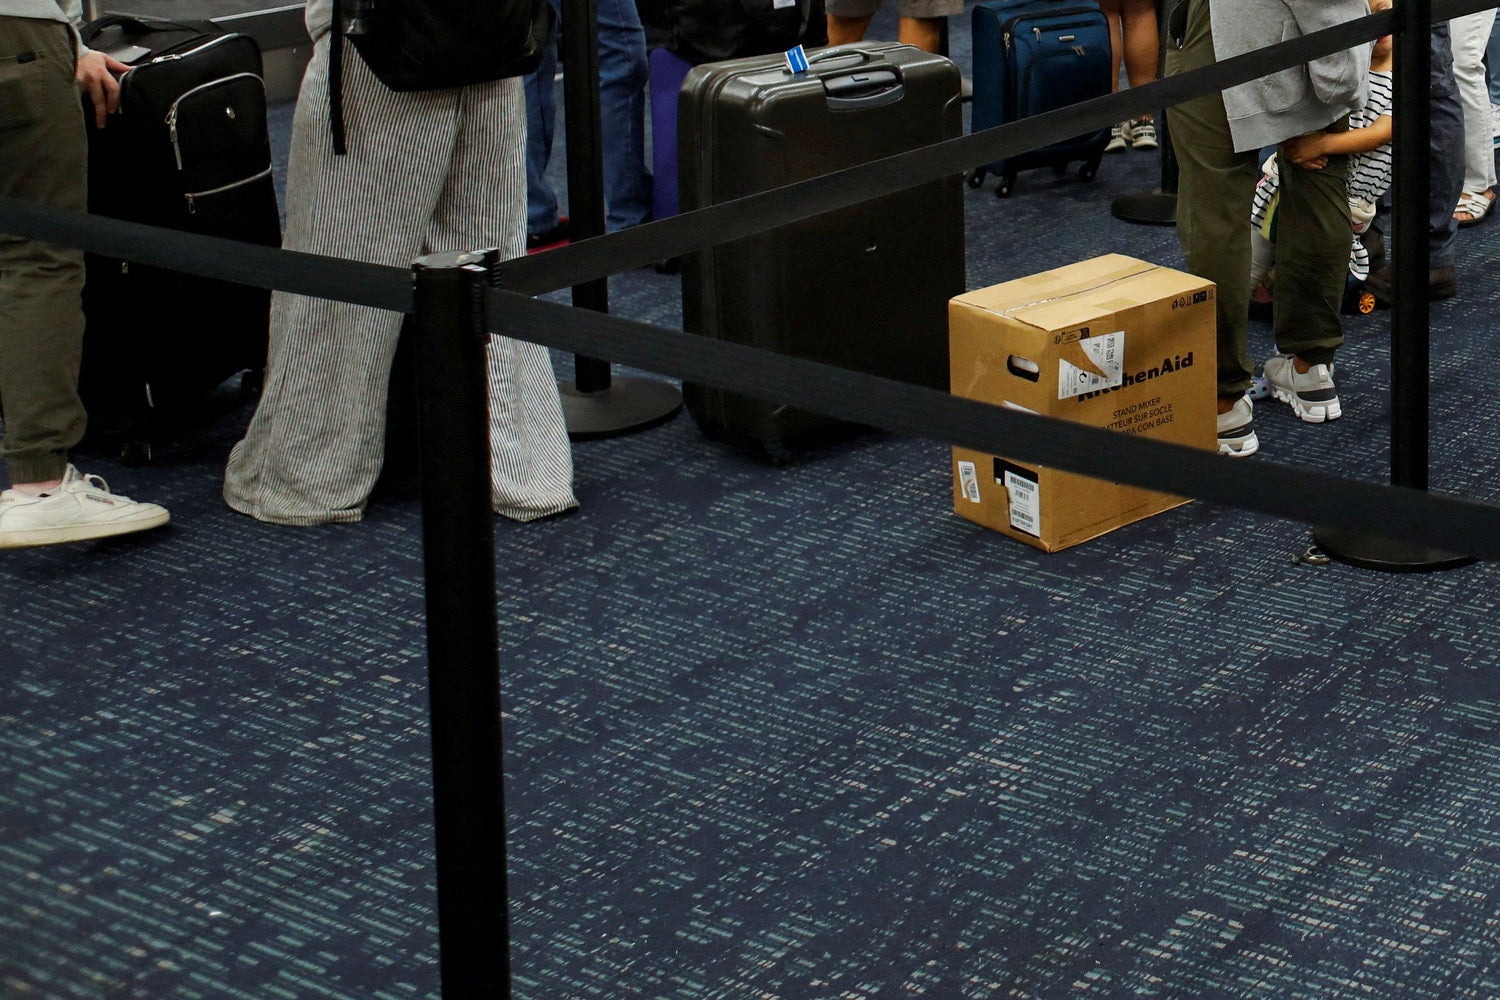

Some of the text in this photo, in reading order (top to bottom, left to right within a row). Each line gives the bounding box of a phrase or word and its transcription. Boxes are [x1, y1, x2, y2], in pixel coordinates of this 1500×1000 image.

[1078, 351, 1194, 402] henAid
[1104, 416, 1133, 431] ATTEUR
[1134, 411, 1148, 424] SUR
[1149, 403, 1173, 418] SOCLE
[1112, 396, 1161, 420] STAND MIXER
[1137, 420, 1155, 433] CON
[1156, 413, 1174, 427] BASE
